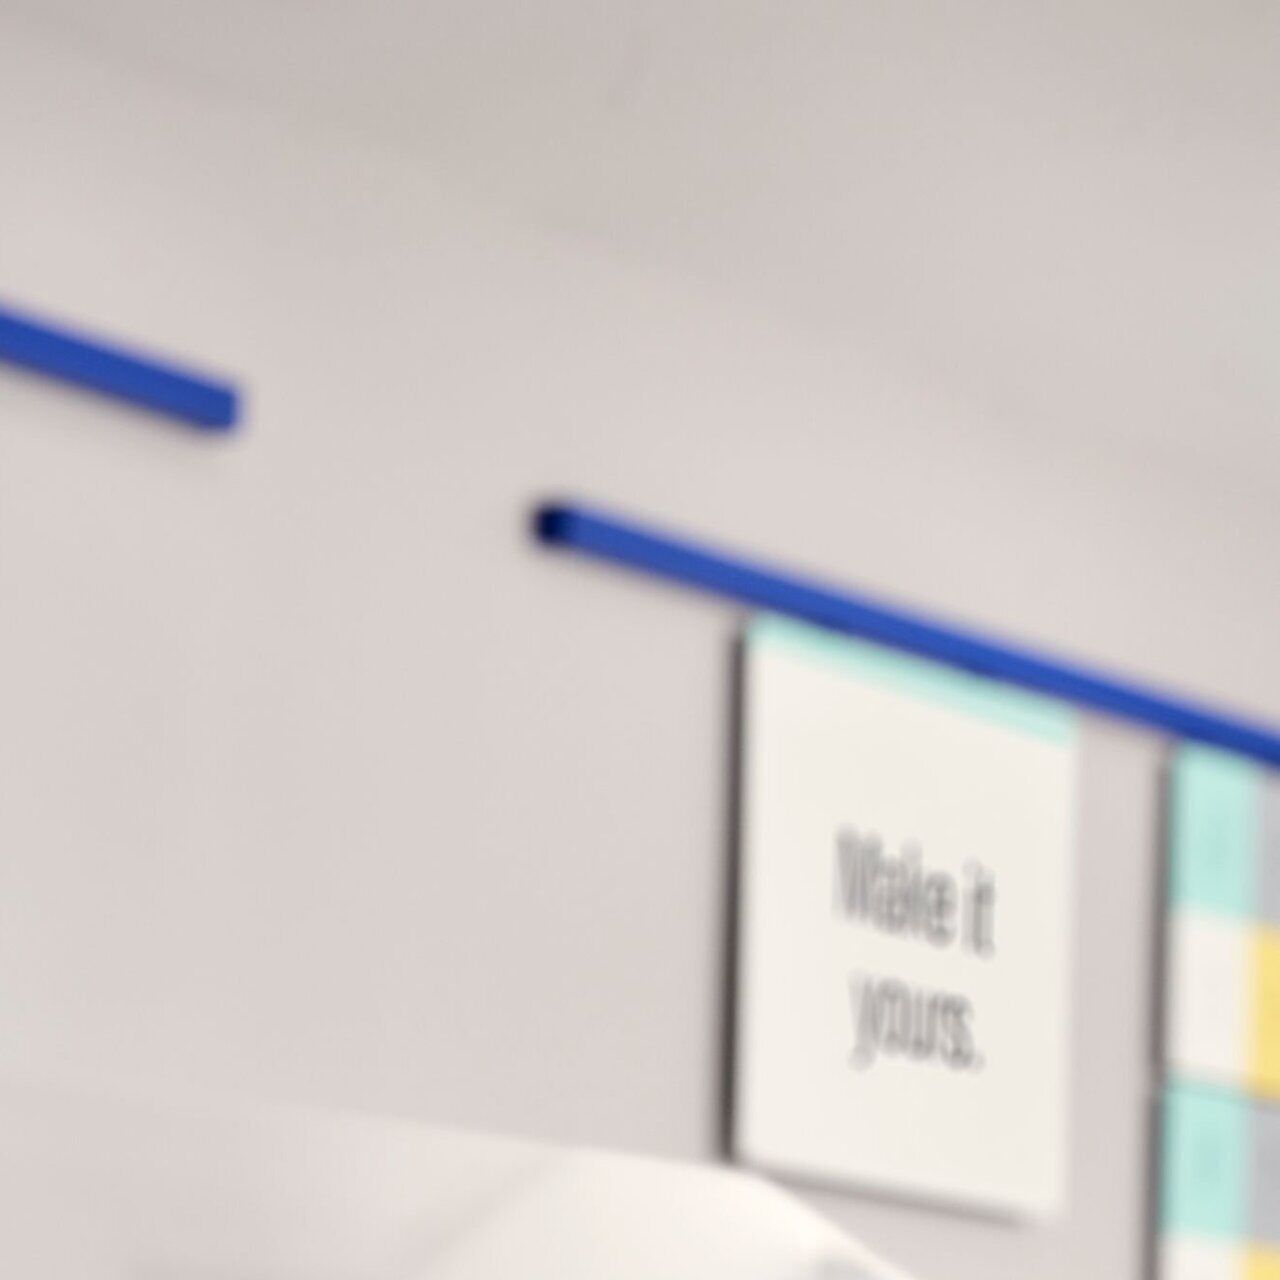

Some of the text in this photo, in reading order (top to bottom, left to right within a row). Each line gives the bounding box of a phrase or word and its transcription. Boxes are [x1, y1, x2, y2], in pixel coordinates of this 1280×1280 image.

[832, 824, 996, 958] Make it
[846, 968, 985, 1072] yours.
